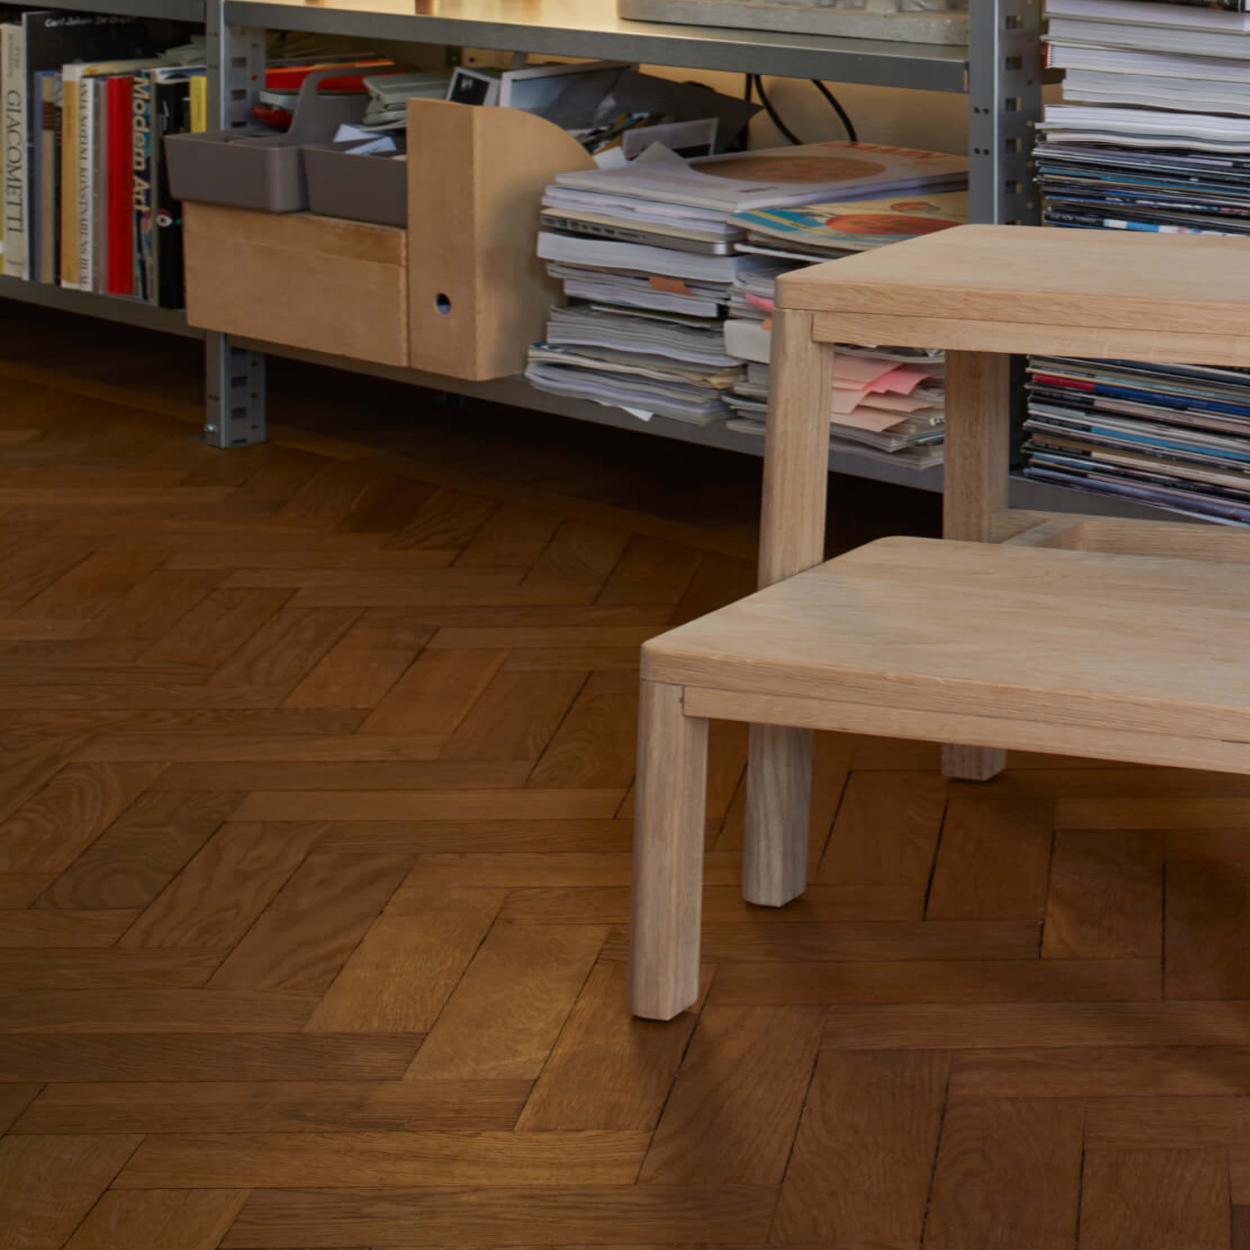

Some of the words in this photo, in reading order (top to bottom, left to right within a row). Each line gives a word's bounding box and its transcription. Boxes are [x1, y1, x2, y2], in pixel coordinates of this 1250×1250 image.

[5, 89, 24, 234] GIACOMETTI
[133, 76, 150, 171] Modern
[134, 175, 150, 212] Art
